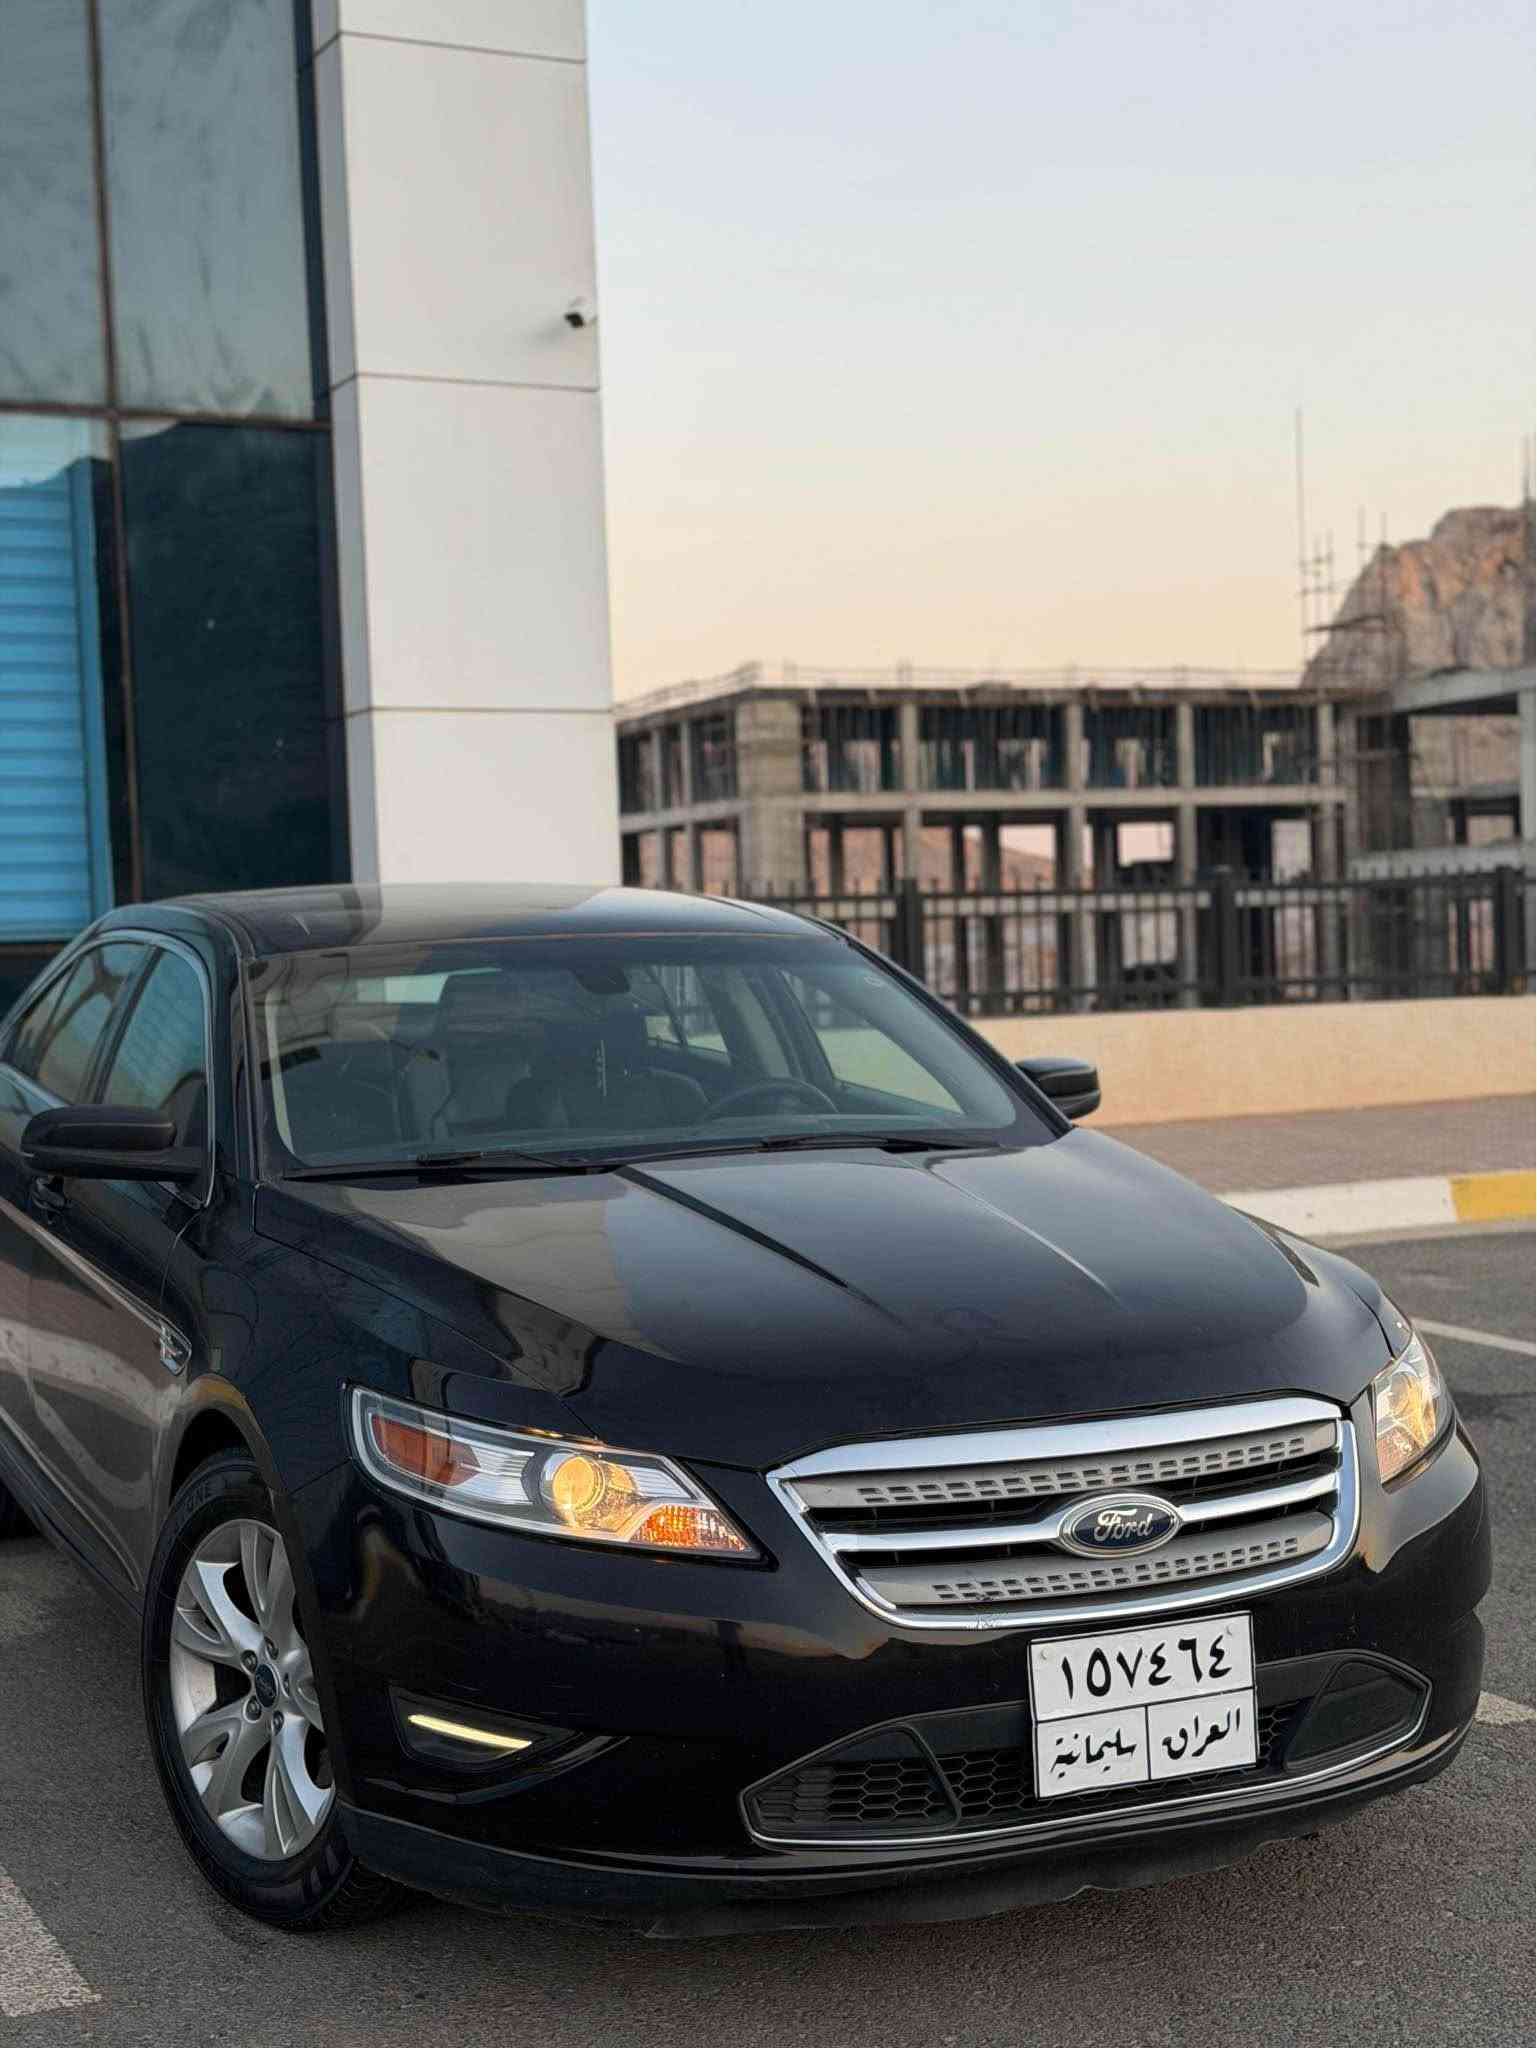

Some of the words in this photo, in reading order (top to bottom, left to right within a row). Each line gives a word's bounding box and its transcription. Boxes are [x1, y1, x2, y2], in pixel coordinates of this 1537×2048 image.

[1094, 1508, 1153, 1541] Ford
[1061, 1635, 1232, 1699] ١٥٧٤٦٤
[1050, 1728, 1137, 1778] سليمانية
[1162, 1708, 1240, 1760] العراق
